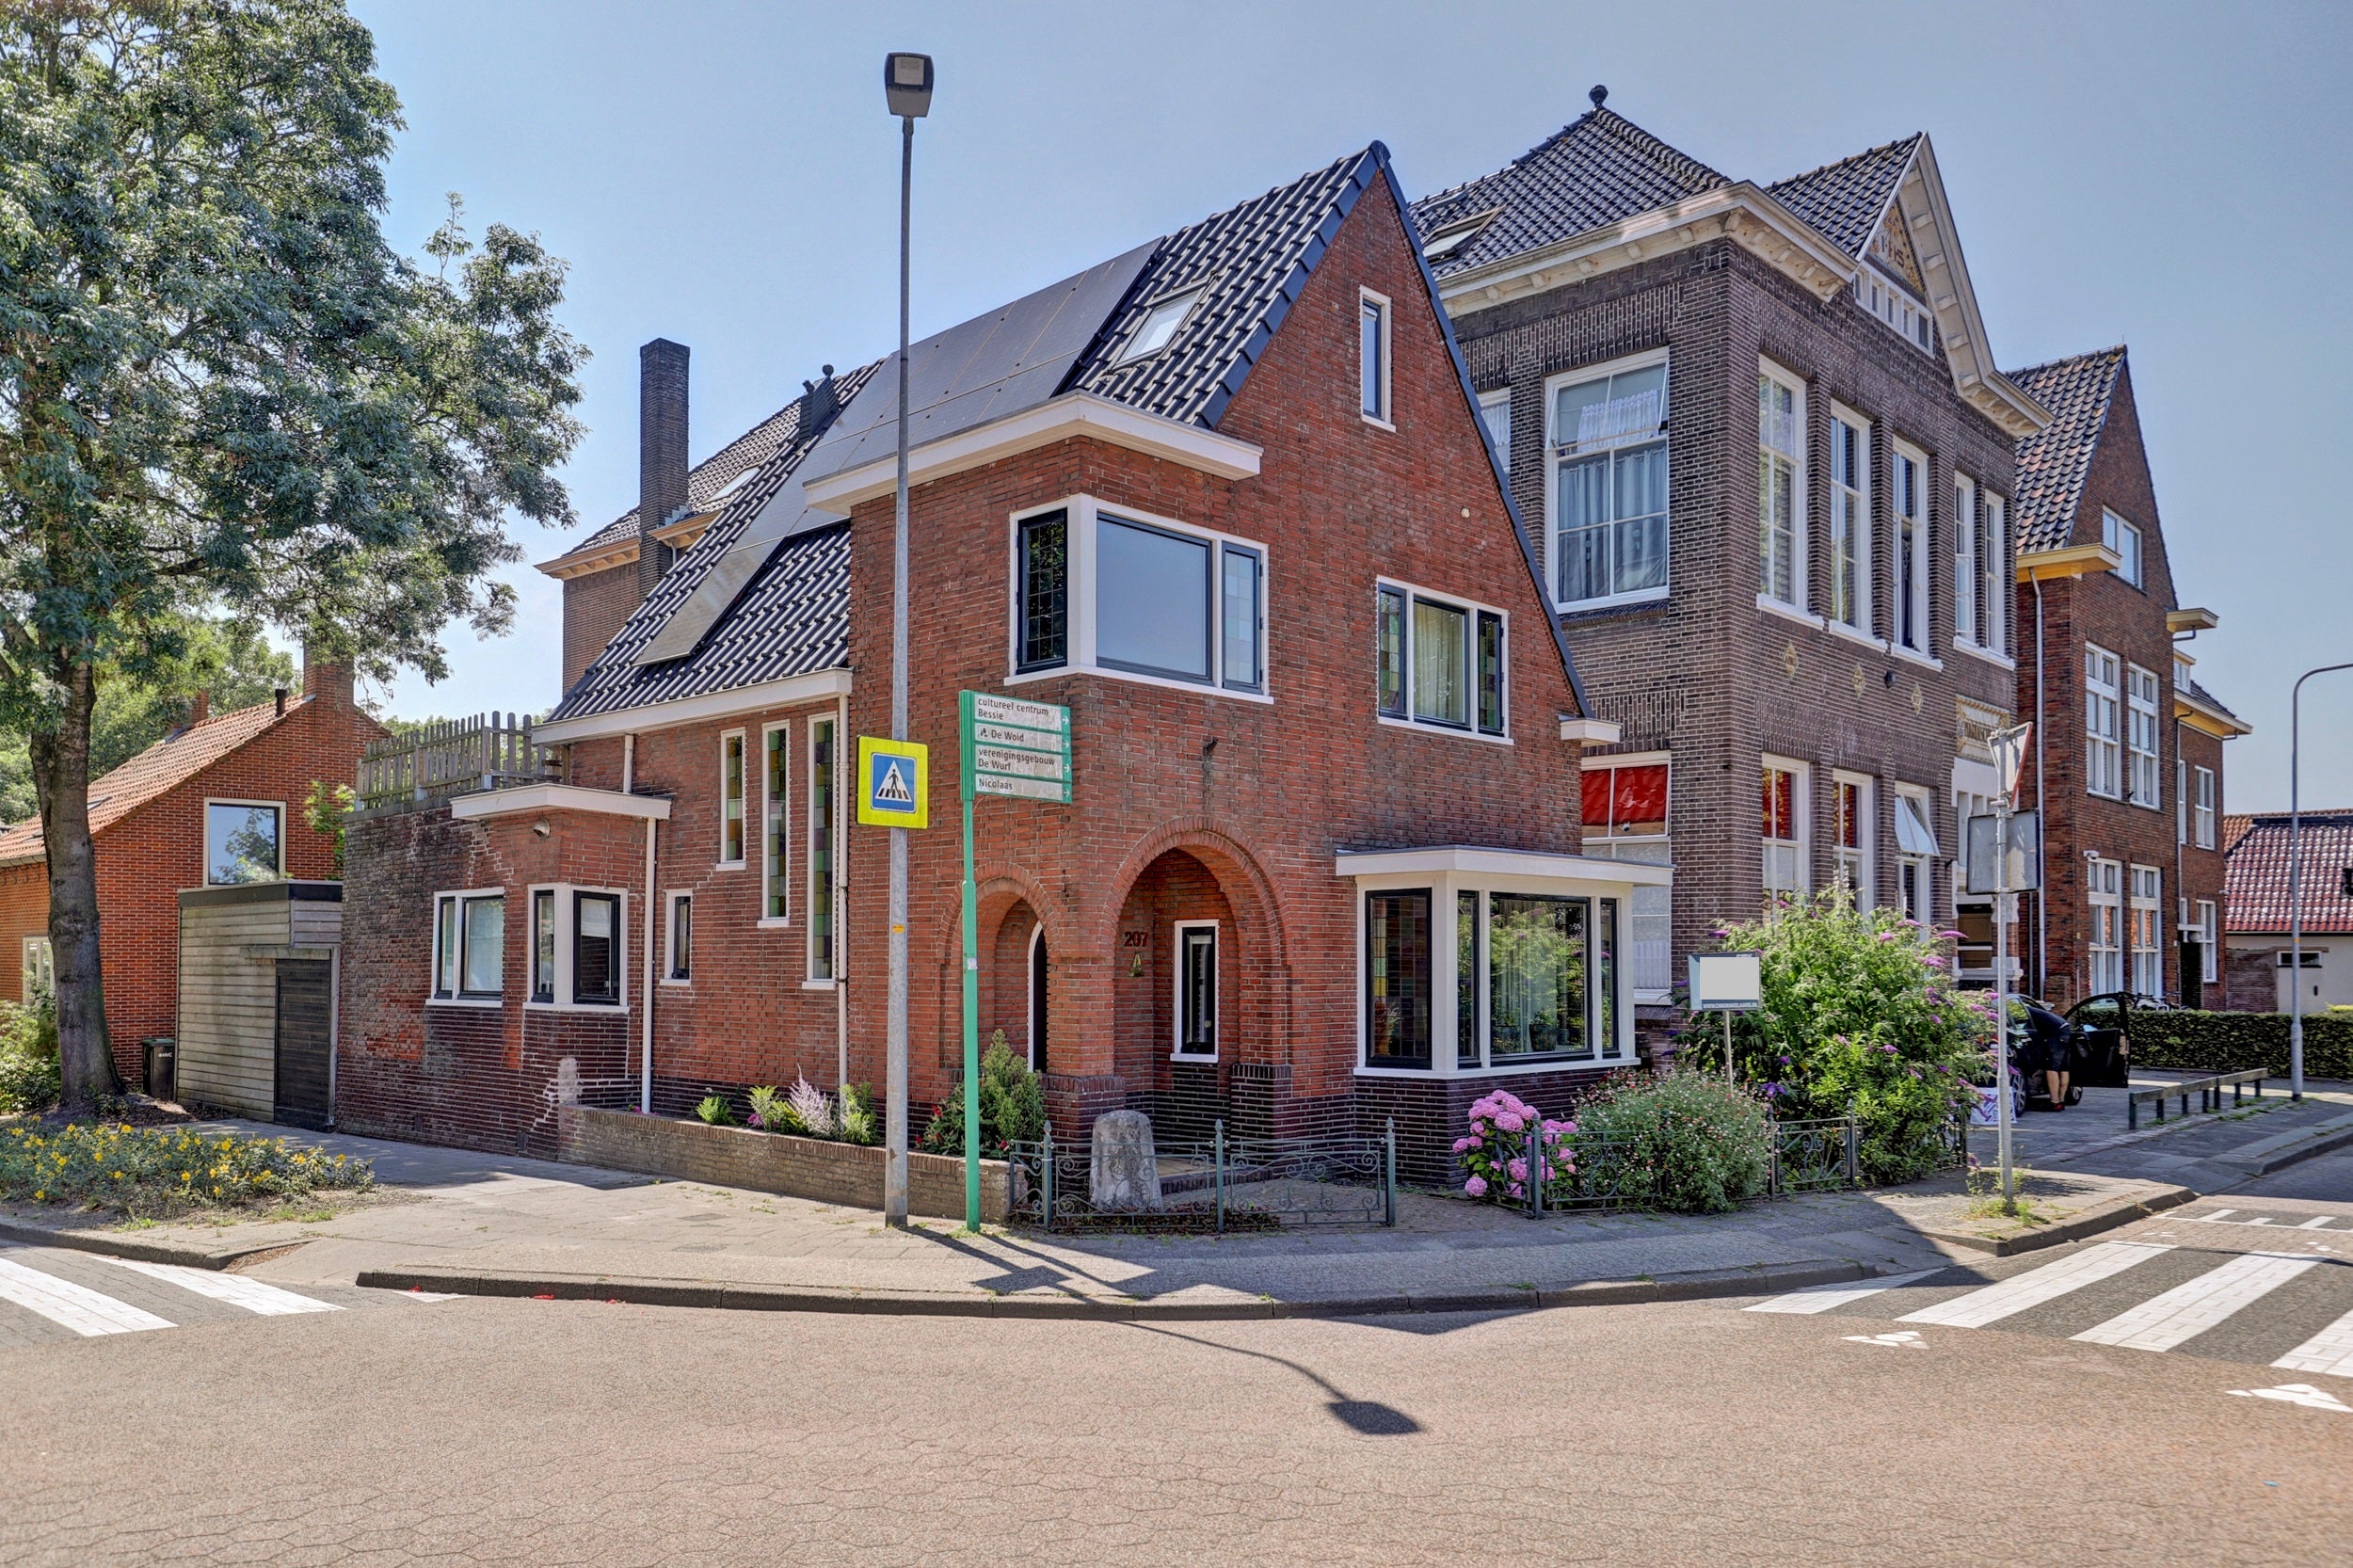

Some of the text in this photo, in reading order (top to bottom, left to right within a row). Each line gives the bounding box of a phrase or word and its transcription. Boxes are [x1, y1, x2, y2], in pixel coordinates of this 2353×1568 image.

[978, 697, 1048, 716] cultureel centrum
[978, 709, 1003, 720] Bessie
[991, 729, 1024, 743] De Woid
[979, 748, 1055, 765] verenigingsgebouw
[979, 759, 1011, 771] De Wurf
[979, 778, 1013, 791] Nicolaas
[1123, 931, 1149, 947] 207
